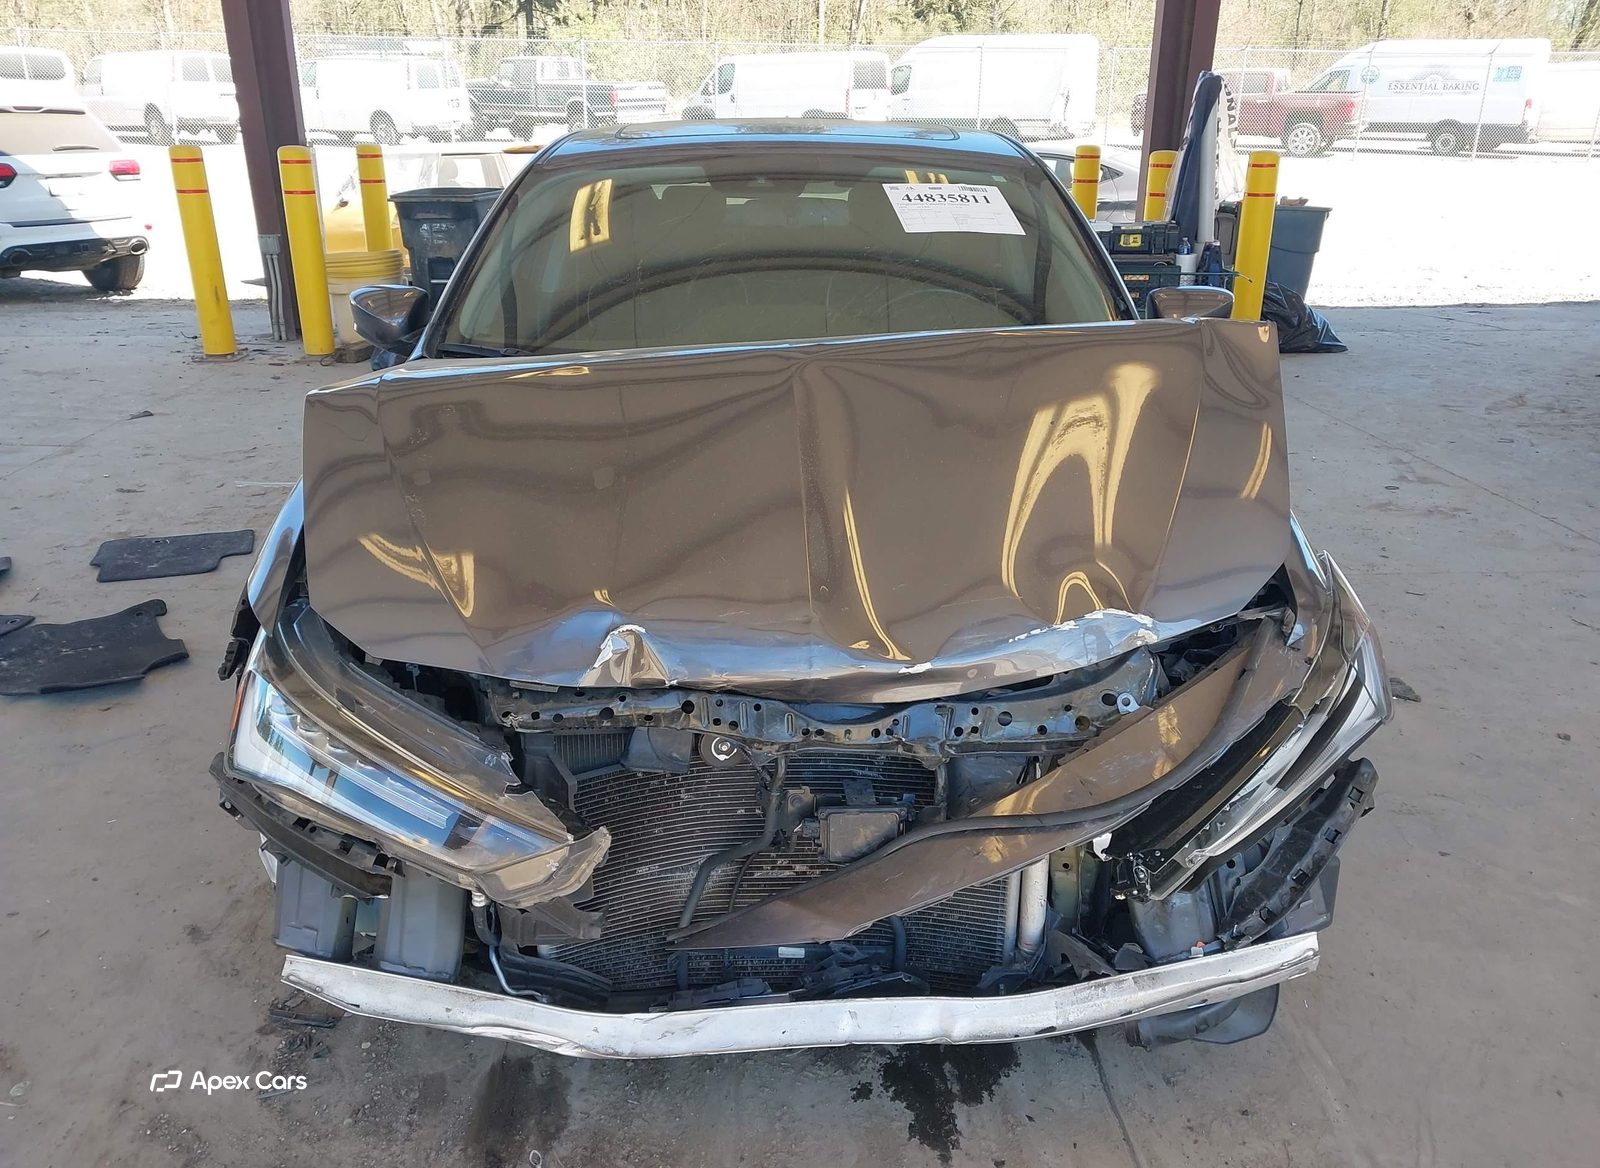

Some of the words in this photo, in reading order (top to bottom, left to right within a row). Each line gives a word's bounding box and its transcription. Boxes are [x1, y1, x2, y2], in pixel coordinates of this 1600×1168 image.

[1387, 82, 1439, 91] ESSENTIAL
[1442, 82, 1480, 91] BAKING
[901, 193, 992, 204] 44835811
